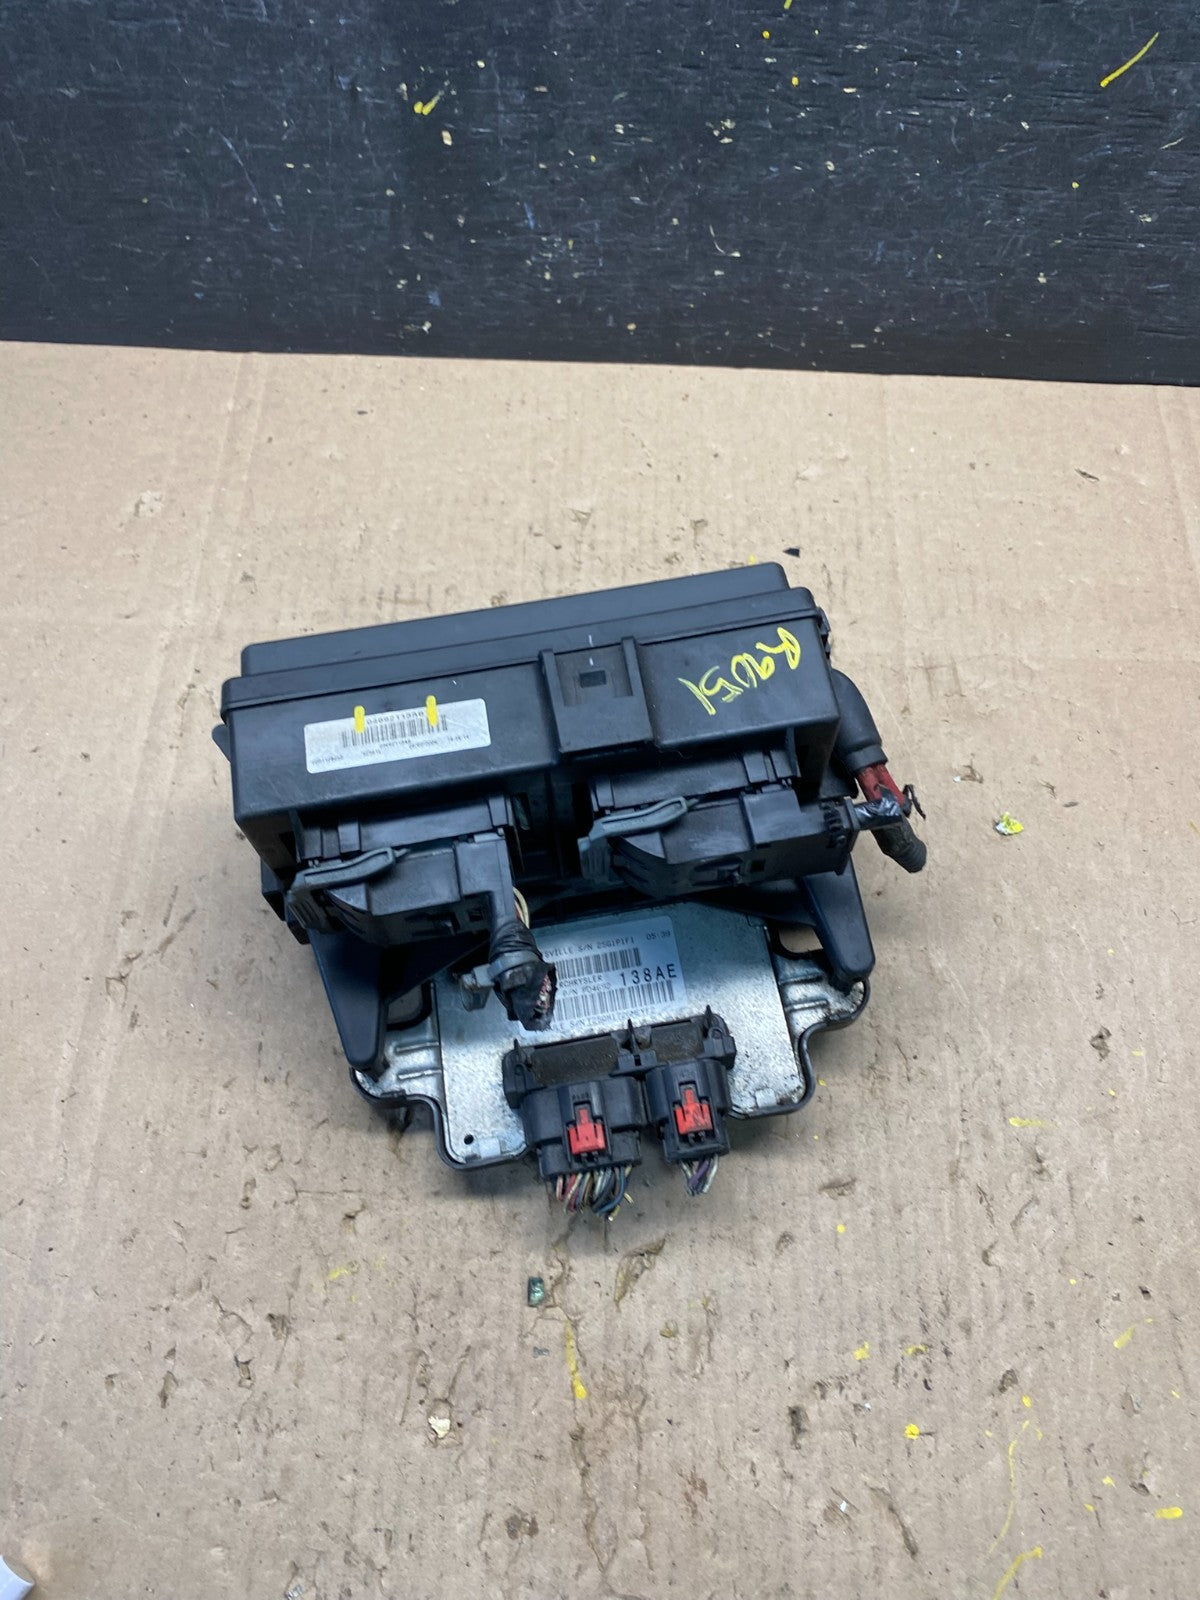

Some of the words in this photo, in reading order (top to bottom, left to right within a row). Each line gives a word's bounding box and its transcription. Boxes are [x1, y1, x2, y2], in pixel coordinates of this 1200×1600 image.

[544, 946, 574, 959] SVILLE
[578, 943, 593, 953] S/N
[559, 973, 604, 988] RCHRYSLER
[619, 963, 678, 987] 138AE
